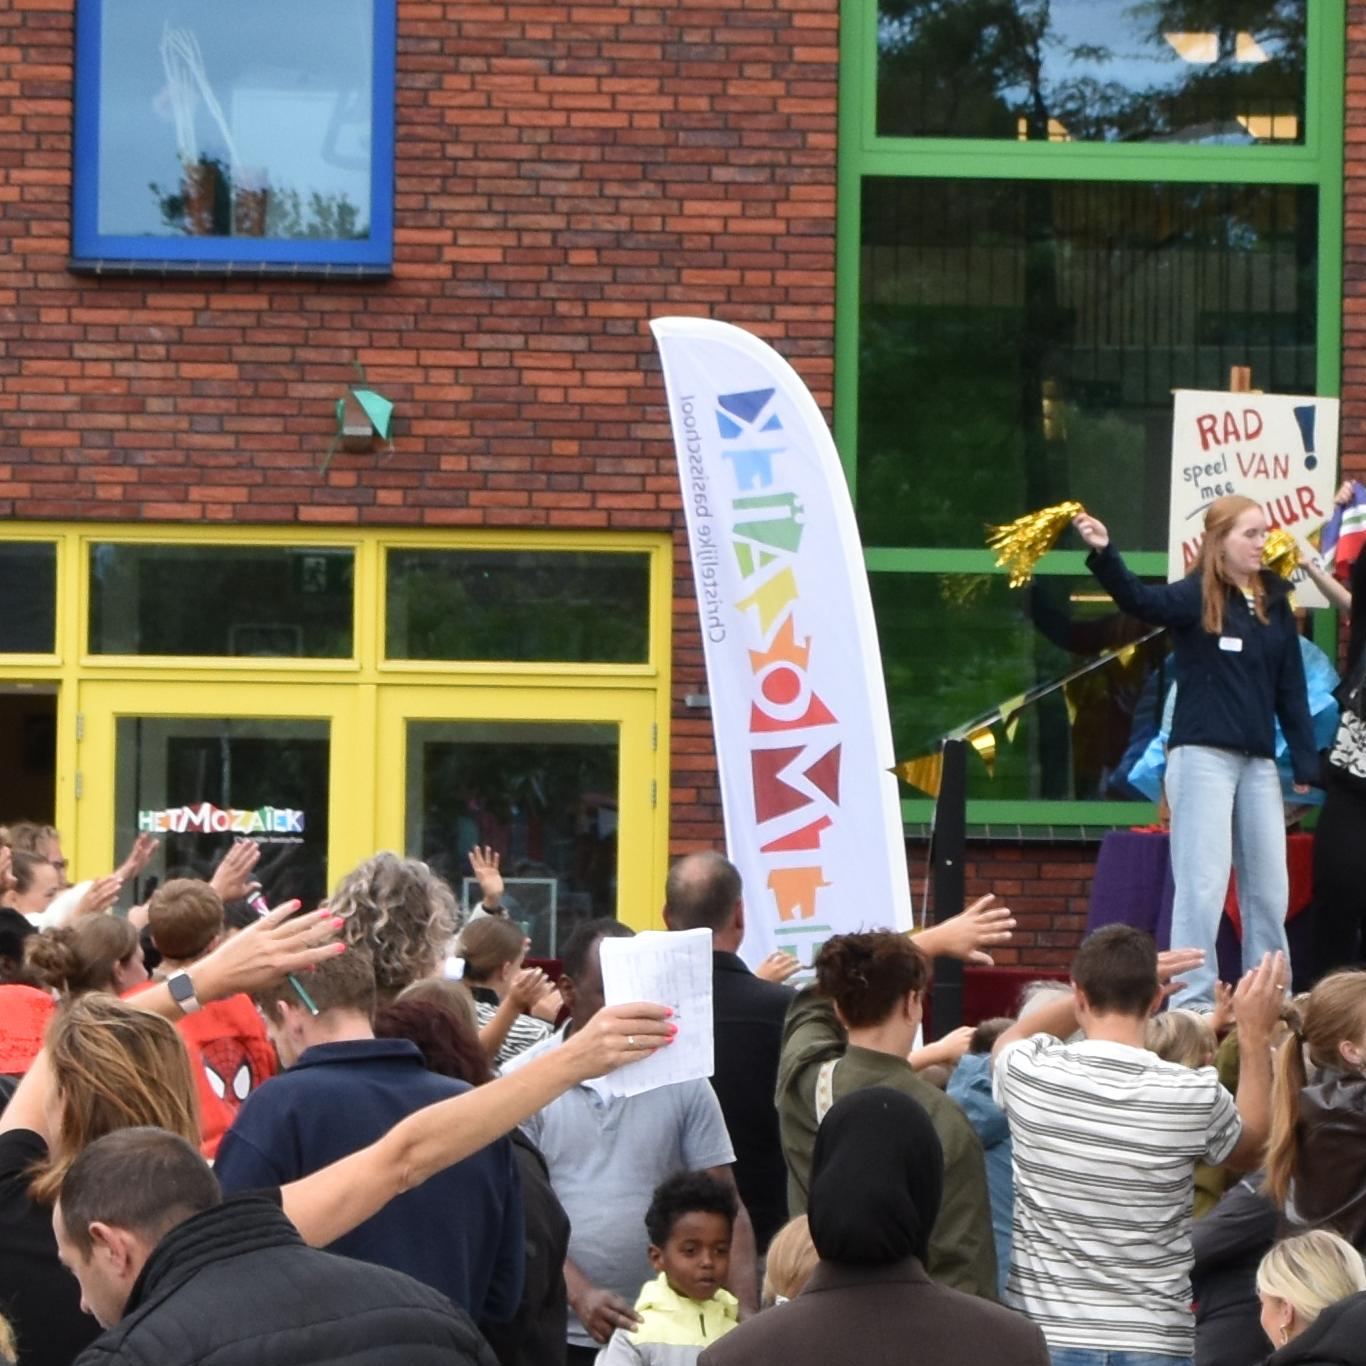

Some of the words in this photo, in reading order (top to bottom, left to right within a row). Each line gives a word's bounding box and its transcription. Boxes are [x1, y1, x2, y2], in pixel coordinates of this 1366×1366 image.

[1196, 408, 1263, 451] RAD
[1183, 453, 1227, 488] speel
[1236, 452, 1289, 479] VAN
[1200, 481, 1235, 500] mee
